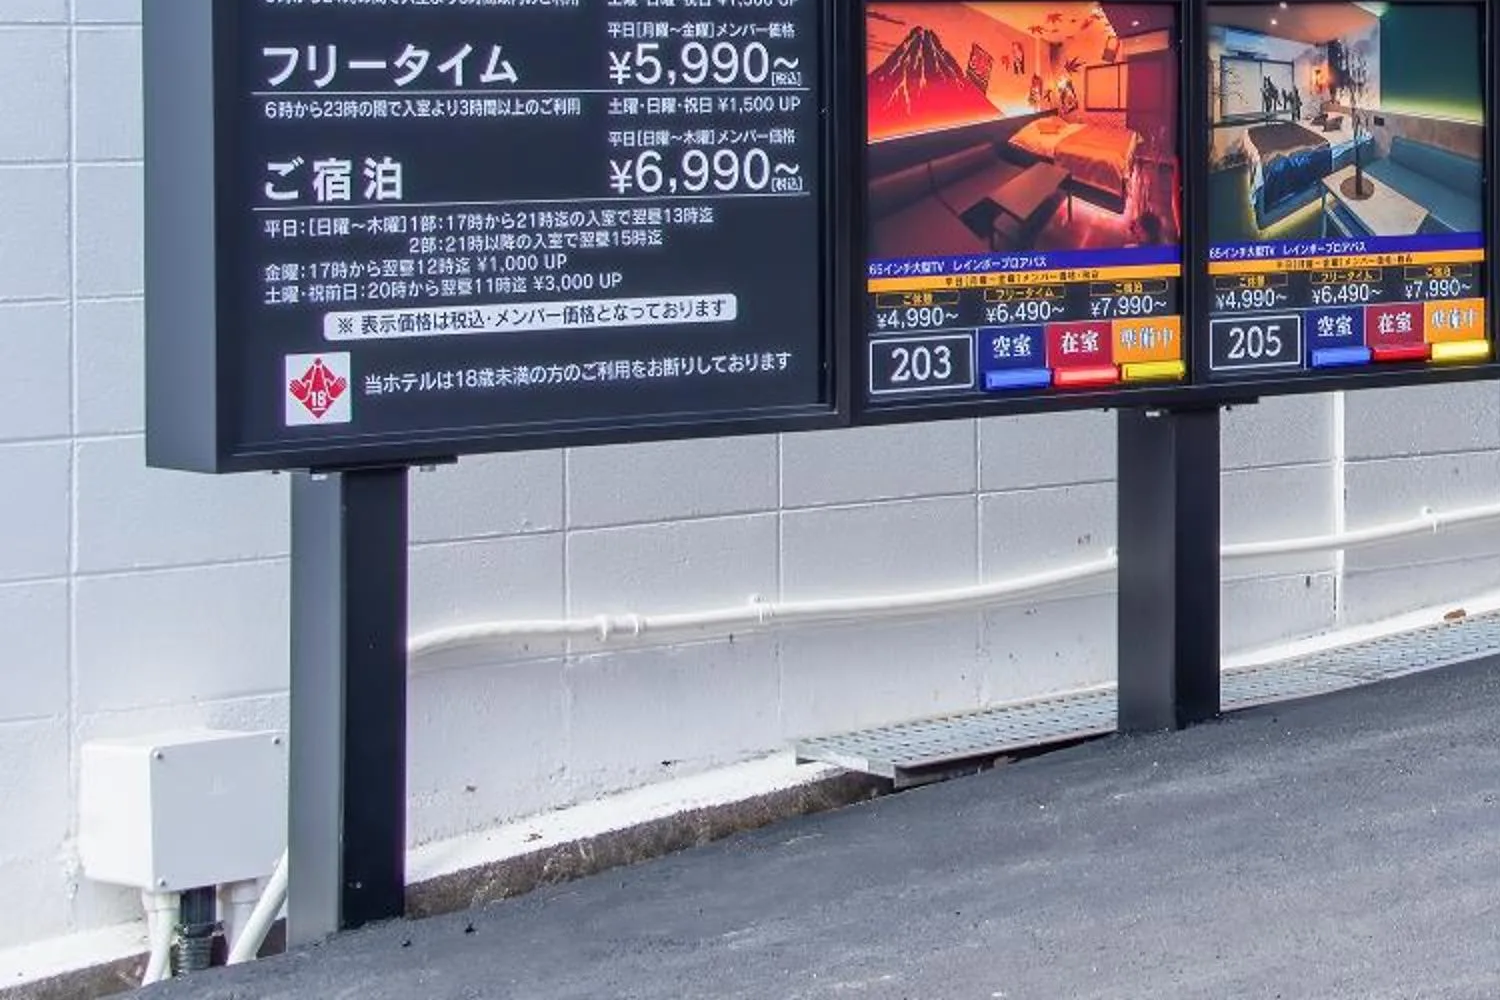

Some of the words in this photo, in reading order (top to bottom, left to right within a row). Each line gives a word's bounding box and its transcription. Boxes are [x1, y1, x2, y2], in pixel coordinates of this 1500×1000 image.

[263, 43, 518, 88] フリータイム
[718, 96, 773, 114] ¥1,500
[779, 96, 800, 110] UP
[265, 156, 401, 201] ご宿泊
[544, 253, 567, 270] UP
[600, 272, 622, 289] UP
[890, 346, 951, 382] 203
[992, 334, 1031, 357] 空室
[1060, 331, 1098, 353] 在室
[1228, 326, 1282, 359] 205
[1317, 316, 1352, 337] 空室
[1378, 313, 1412, 334] 在室
